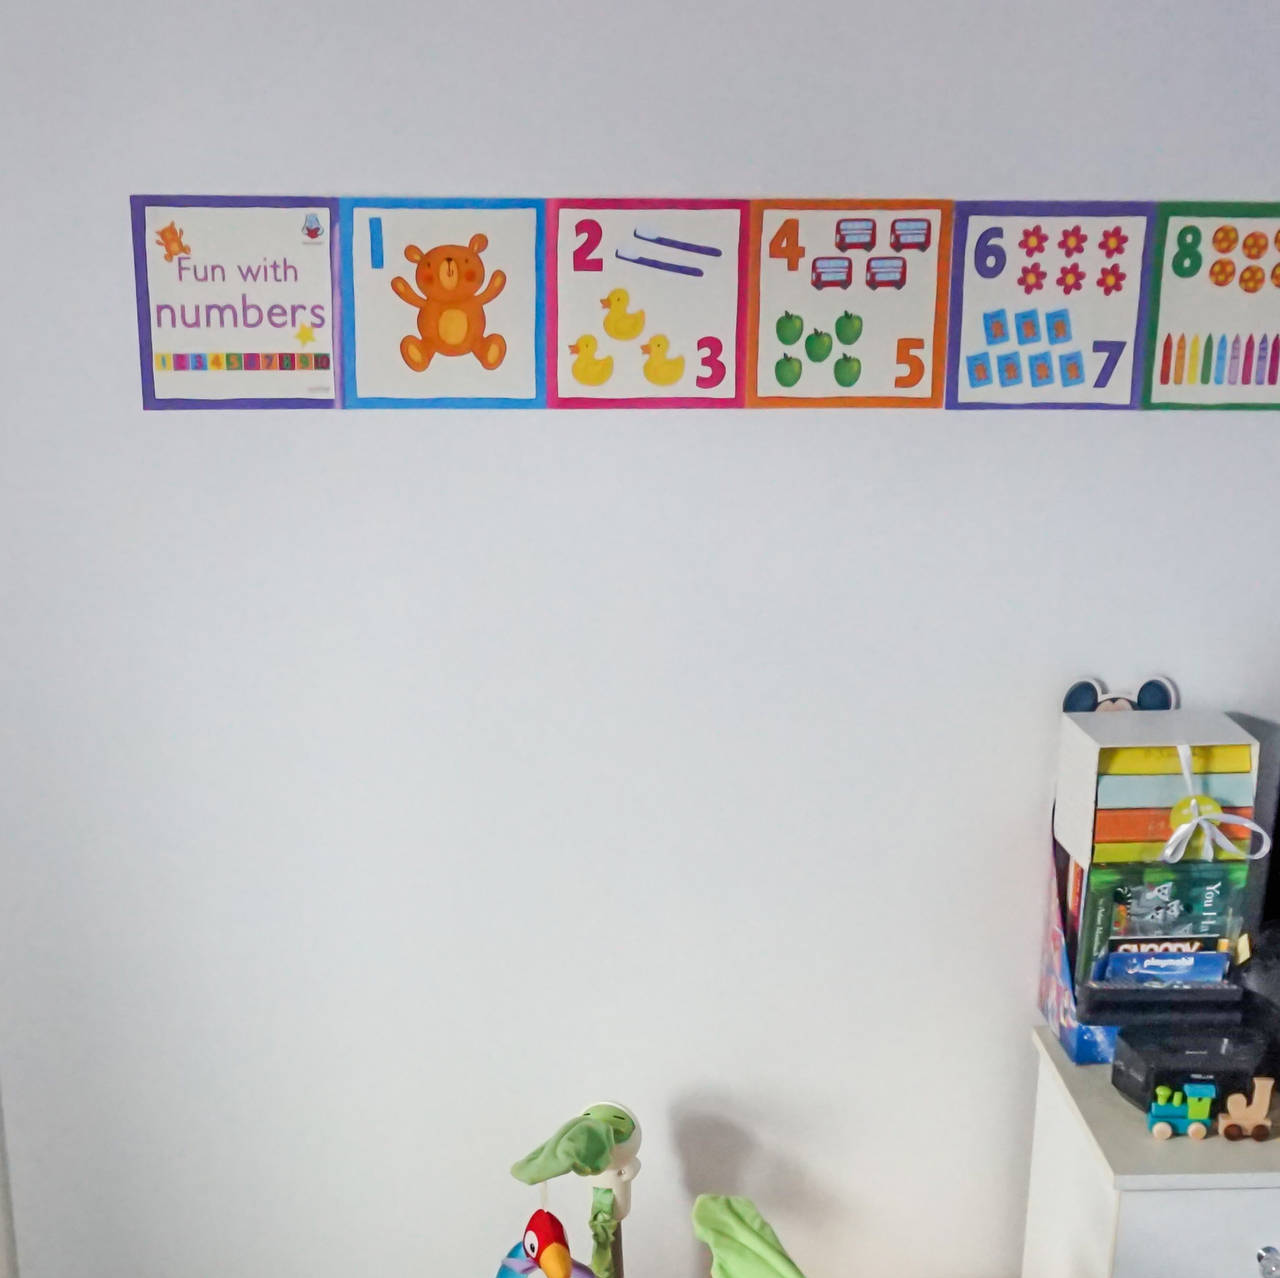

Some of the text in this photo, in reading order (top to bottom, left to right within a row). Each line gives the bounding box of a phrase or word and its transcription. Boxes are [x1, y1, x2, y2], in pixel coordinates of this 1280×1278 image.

[177, 256, 298, 282] Fun with
[573, 219, 604, 272] 2
[769, 218, 806, 272] 4
[974, 226, 1007, 278] 6
[1171, 225, 1203, 277] 8
[156, 293, 326, 329] numbers
[695, 335, 727, 389] 3
[894, 337, 926, 388] 5
[1092, 340, 1127, 388] 7
